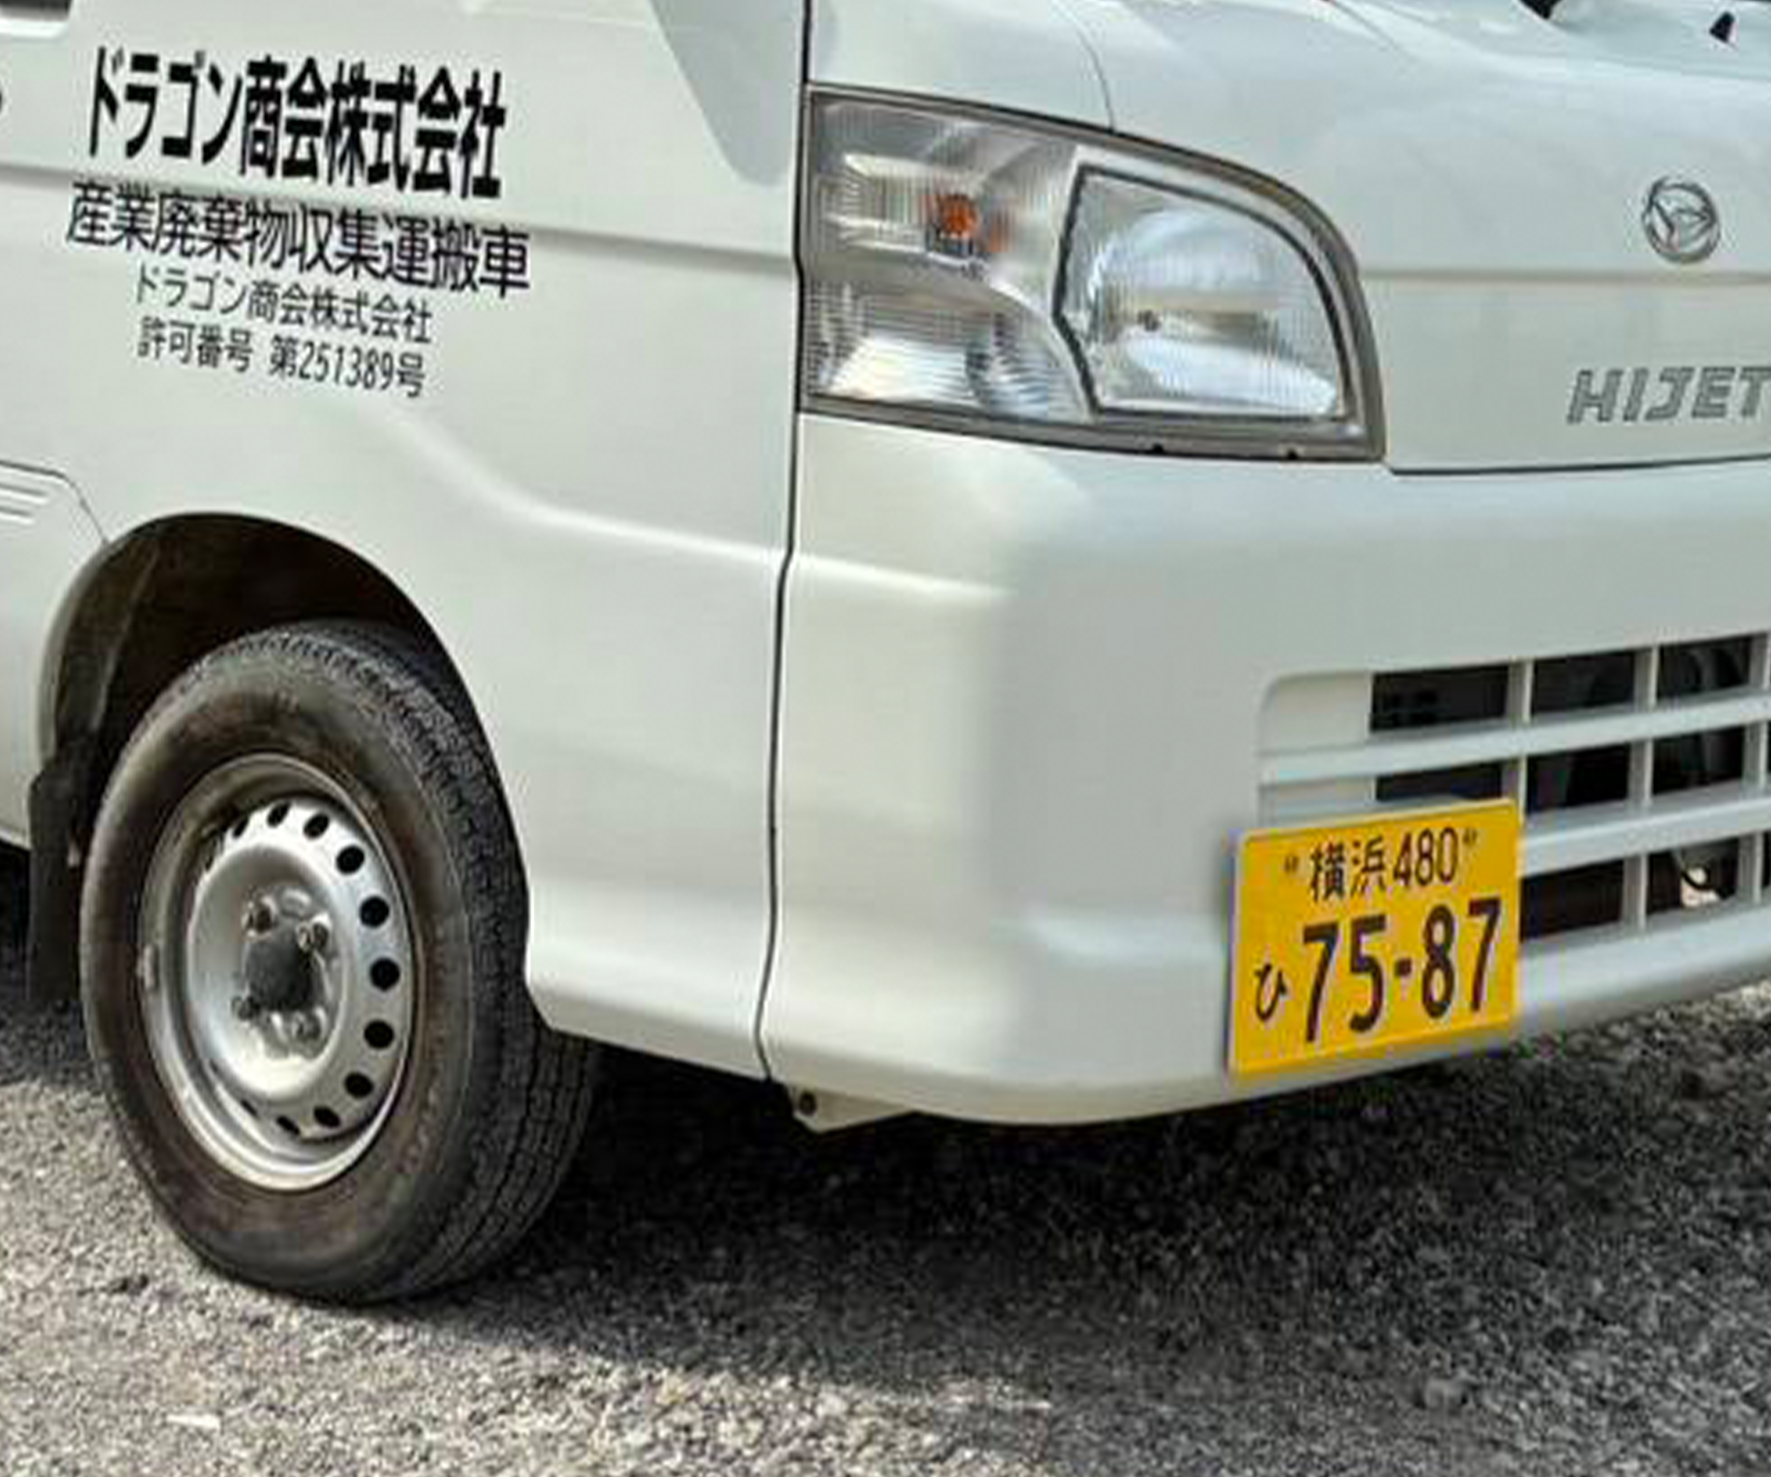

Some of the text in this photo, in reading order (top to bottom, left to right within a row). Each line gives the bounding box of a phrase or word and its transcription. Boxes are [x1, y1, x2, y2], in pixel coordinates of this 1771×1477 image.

[89, 46, 506, 199] ドラゴン商会株式会社
[66, 179, 531, 299] 産業廃棄物収集運搬車
[136, 263, 432, 345] ドラゴン商会株式会社
[137, 314, 426, 399] 許可番号 第251389号
[1302, 897, 1502, 1043] 75-87
